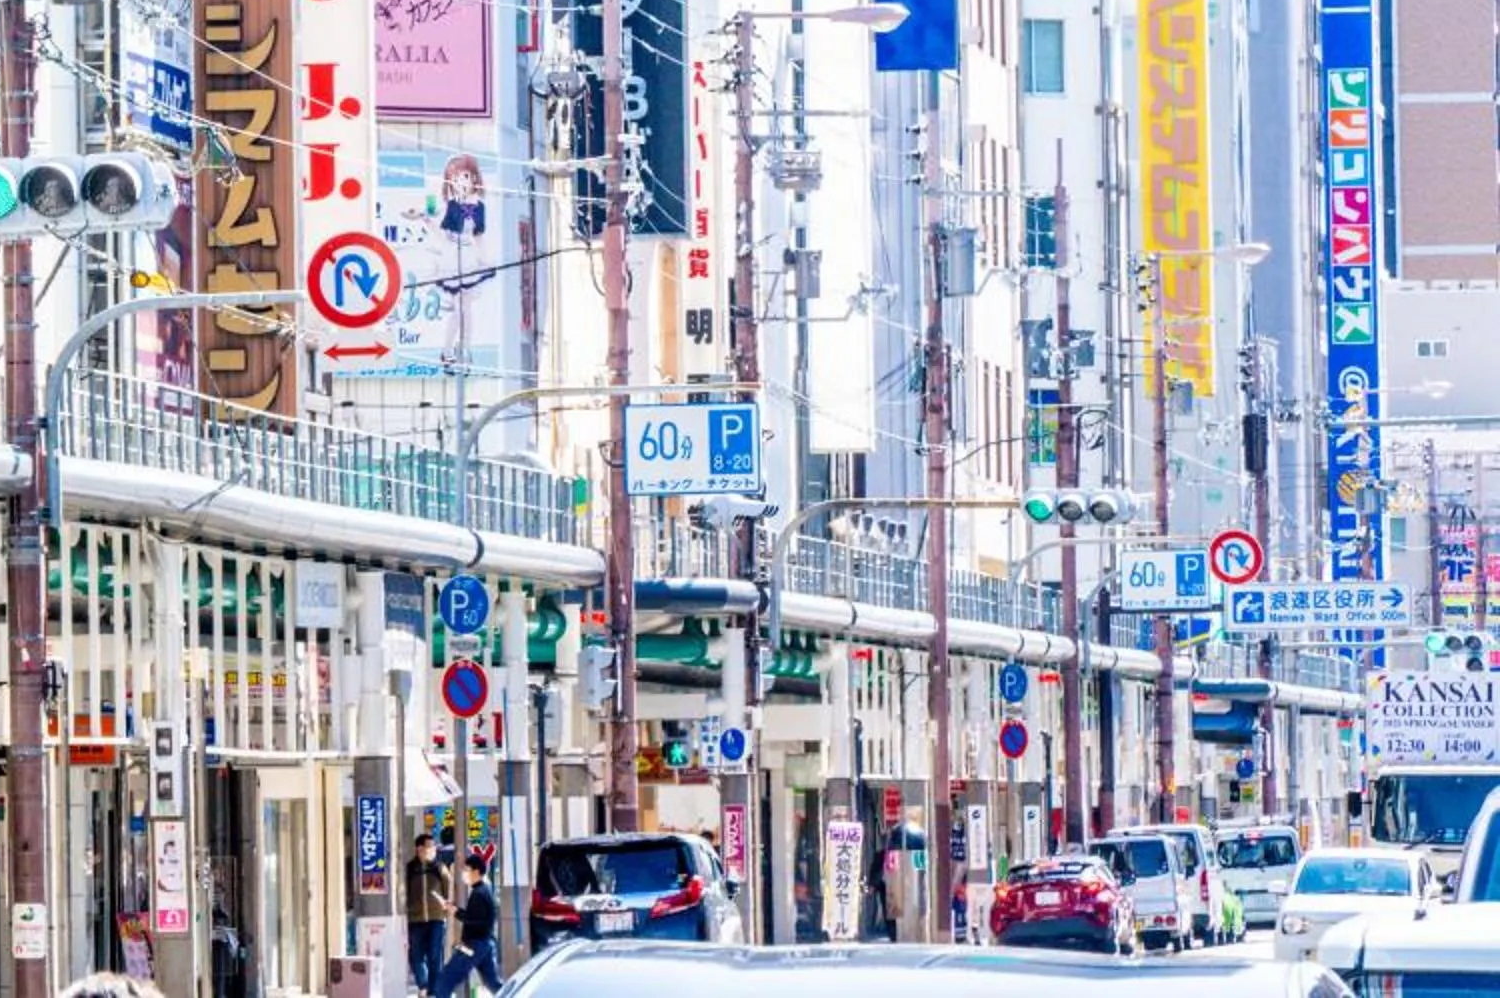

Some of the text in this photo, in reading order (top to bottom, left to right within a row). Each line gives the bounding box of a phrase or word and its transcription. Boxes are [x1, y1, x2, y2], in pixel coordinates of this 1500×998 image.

[721, 414, 743, 450] P
[451, 589, 469, 625] P
[1269, 589, 1375, 610] 浪速区役所
[1384, 681, 1493, 703] KANSAI
[1382, 704, 1495, 718] COLLECTION
